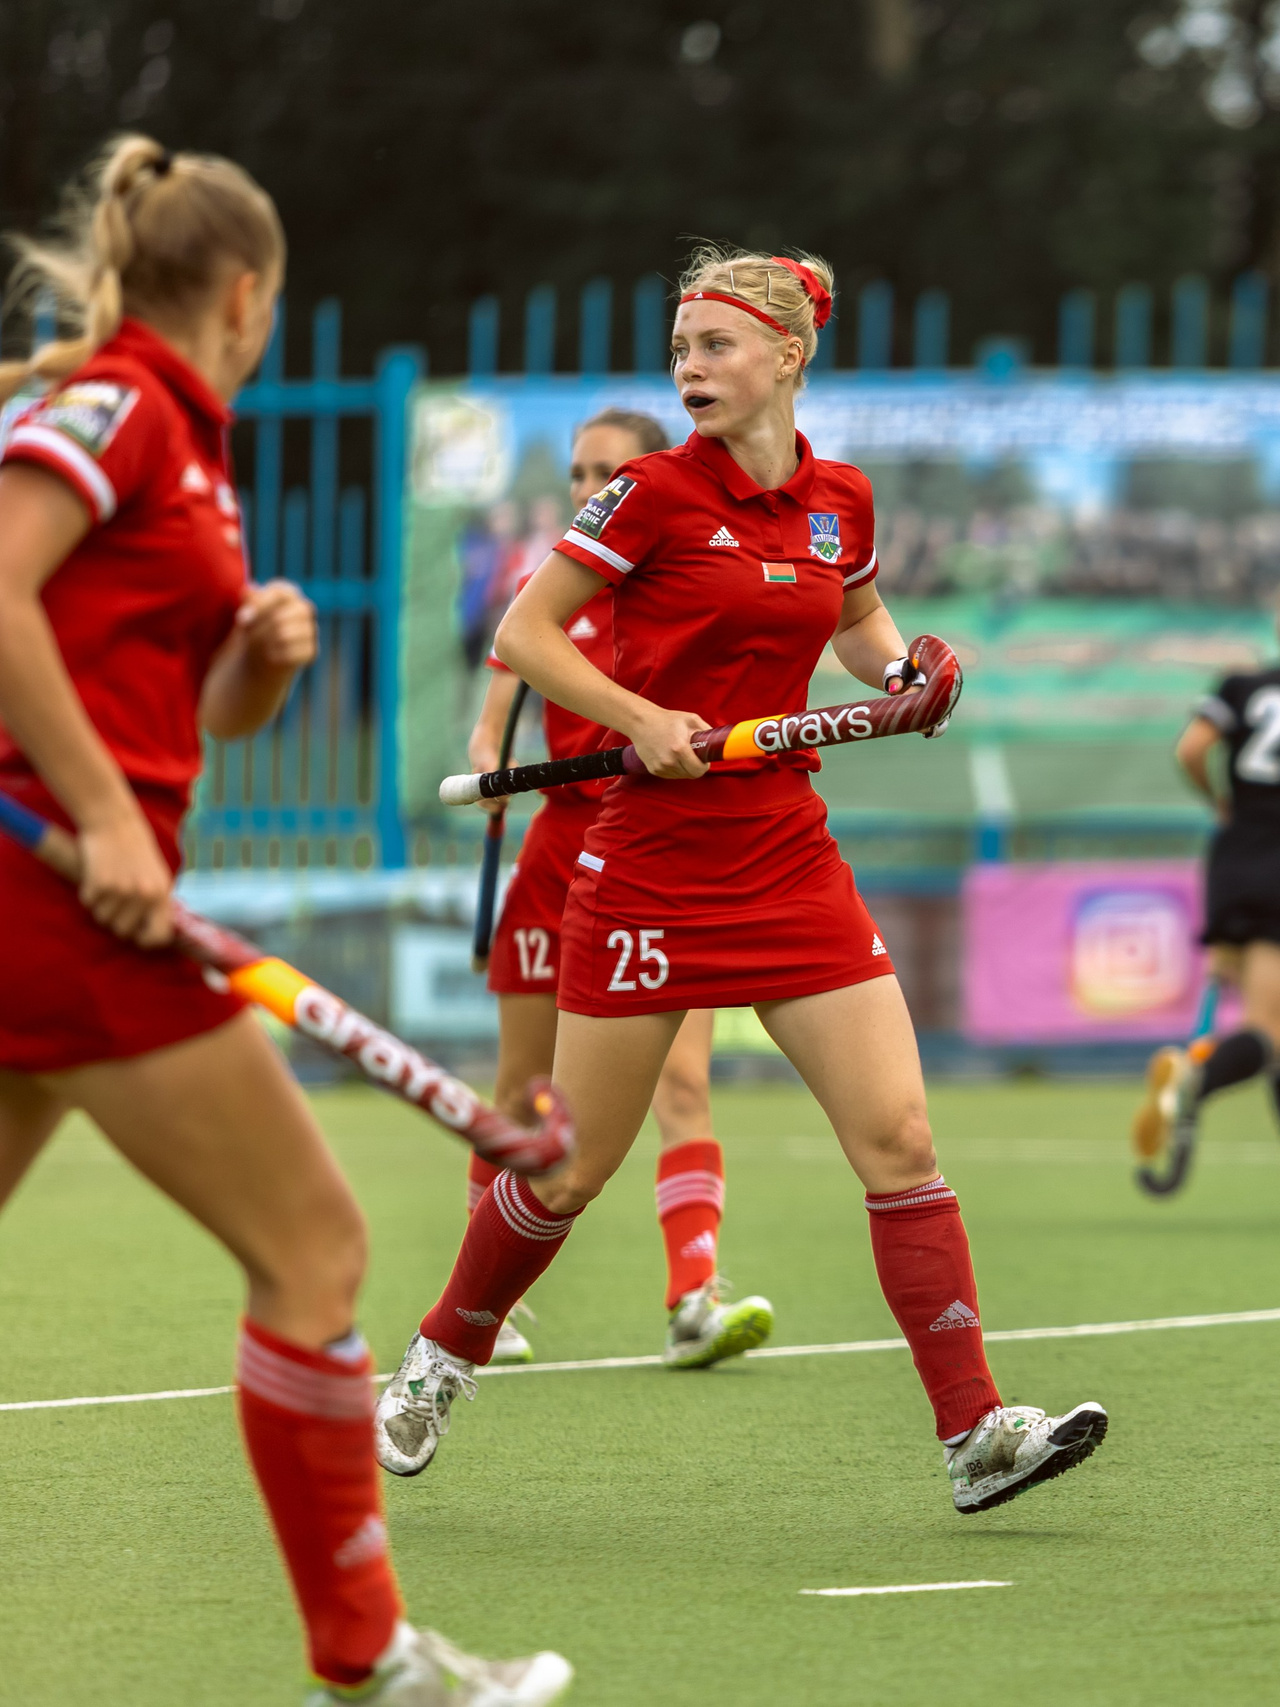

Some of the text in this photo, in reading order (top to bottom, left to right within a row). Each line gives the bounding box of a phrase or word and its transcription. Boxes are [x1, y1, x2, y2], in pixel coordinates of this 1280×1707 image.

[708, 538, 740, 548] adidas
[513, 927, 555, 981] 12
[606, 929, 670, 992] 25
